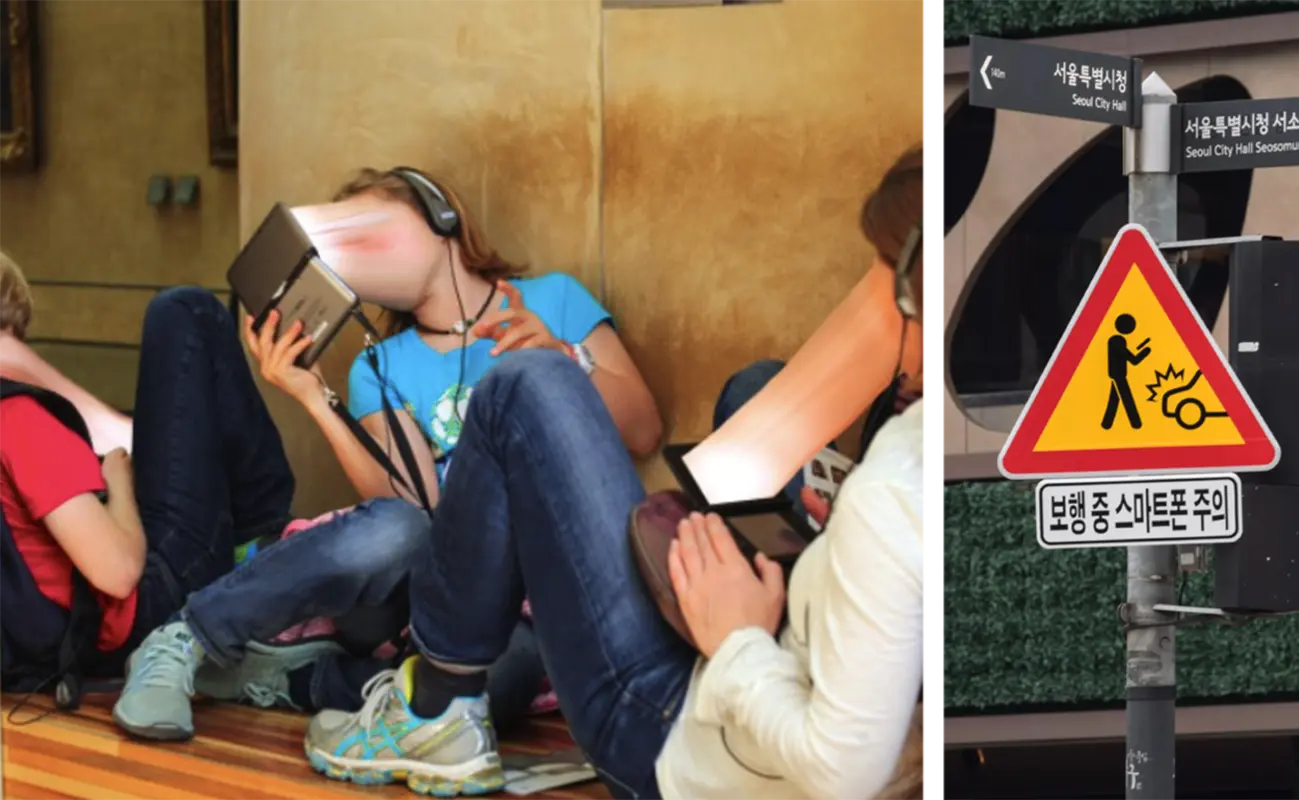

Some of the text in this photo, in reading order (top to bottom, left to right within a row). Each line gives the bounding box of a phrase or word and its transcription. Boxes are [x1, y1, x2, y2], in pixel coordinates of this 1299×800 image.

[1053, 61, 1128, 94] 서울특별시청
[1071, 93, 1127, 112] Seoul City Hall
[1184, 112, 1270, 139] 서울특별시청
[1185, 146, 1212, 159] Seoul
[1214, 144, 1234, 157] City
[1235, 141, 1254, 154] Hall
[1050, 484, 1229, 535] 보행 중 스마트폰 주의
